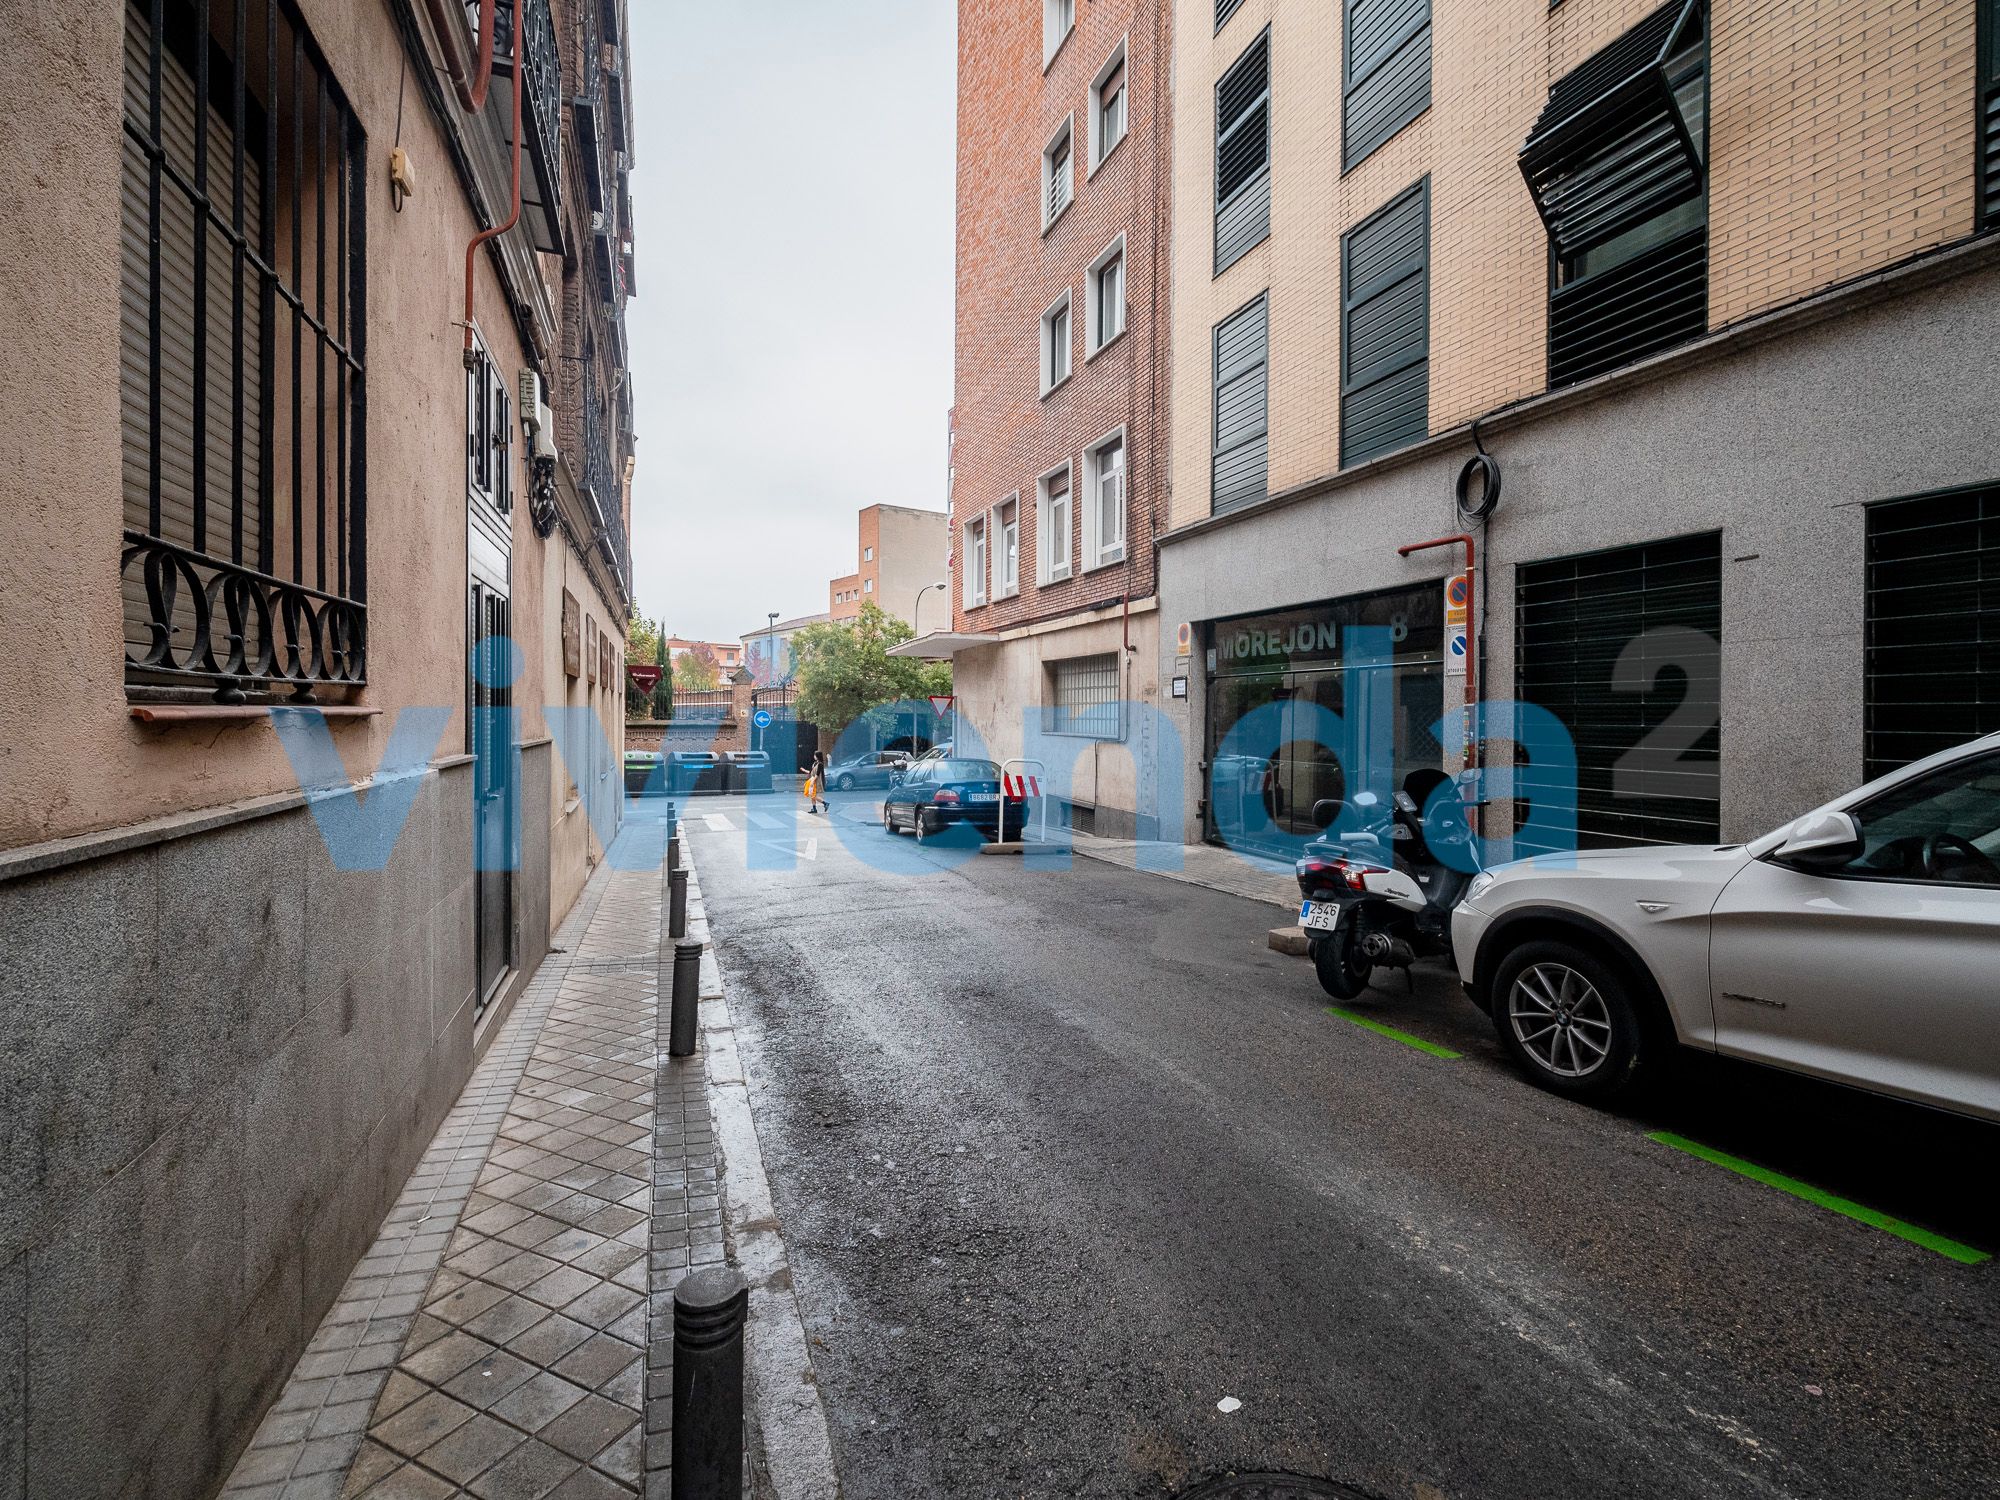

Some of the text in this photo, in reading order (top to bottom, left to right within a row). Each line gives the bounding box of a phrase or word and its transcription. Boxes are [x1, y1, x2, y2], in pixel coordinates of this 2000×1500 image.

[1216, 612, 1408, 660] MOREJON 8
[1310, 903, 1337, 917] 2546
[1307, 915, 1329, 928] JFS
